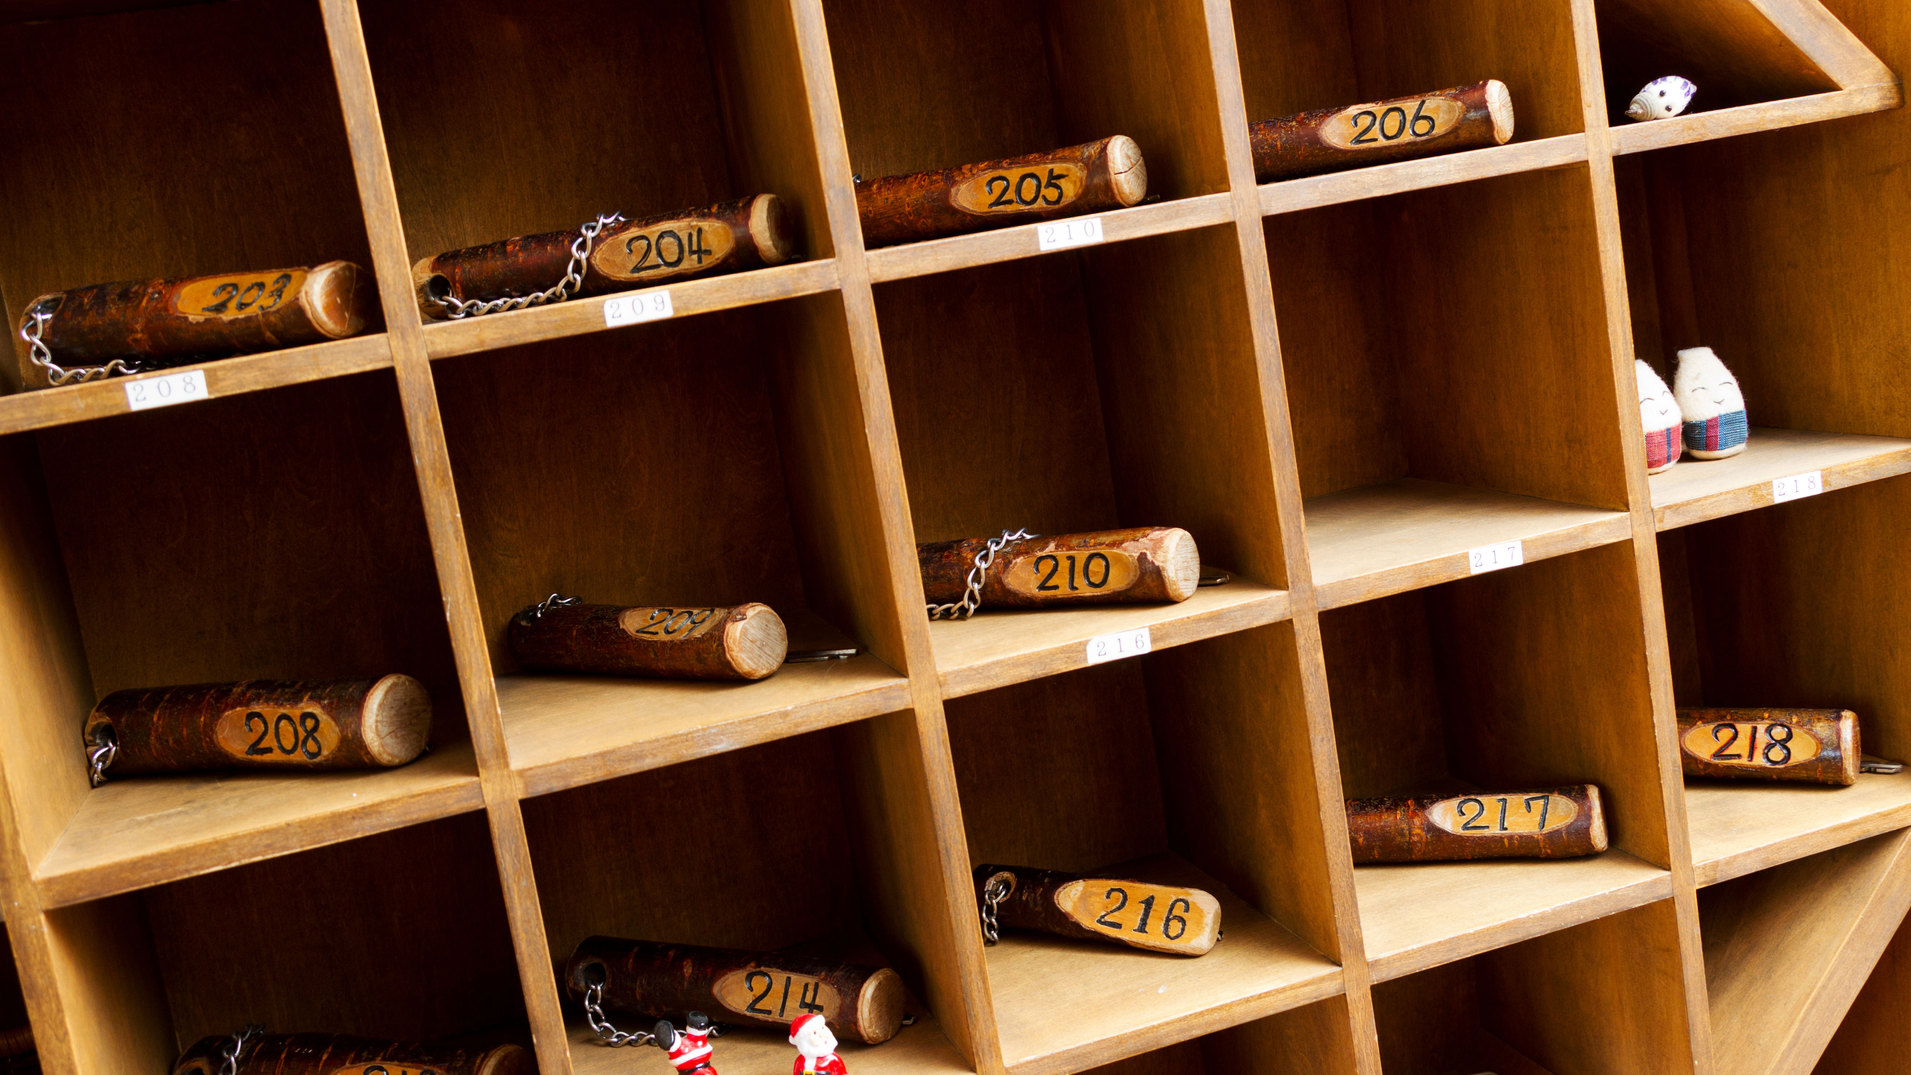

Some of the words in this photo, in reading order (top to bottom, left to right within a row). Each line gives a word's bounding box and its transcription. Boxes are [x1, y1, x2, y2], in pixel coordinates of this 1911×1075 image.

[1350, 99, 1436, 145] 206
[985, 168, 1069, 209] 205
[626, 227, 712, 274] 204
[1045, 221, 1095, 244] 210
[202, 273, 292, 314] 203
[610, 295, 665, 319] 209
[133, 375, 196, 402] 208
[1777, 475, 1816, 497] 218
[1033, 552, 1110, 592] 210
[1474, 546, 1516, 568] 217
[635, 608, 715, 640] 209
[1096, 634, 1145, 657] 216
[245, 711, 322, 760] 208
[1711, 723, 1794, 767] 218
[1457, 795, 1550, 832] 217
[1096, 887, 1190, 941] 216
[745, 970, 824, 1018] 214
